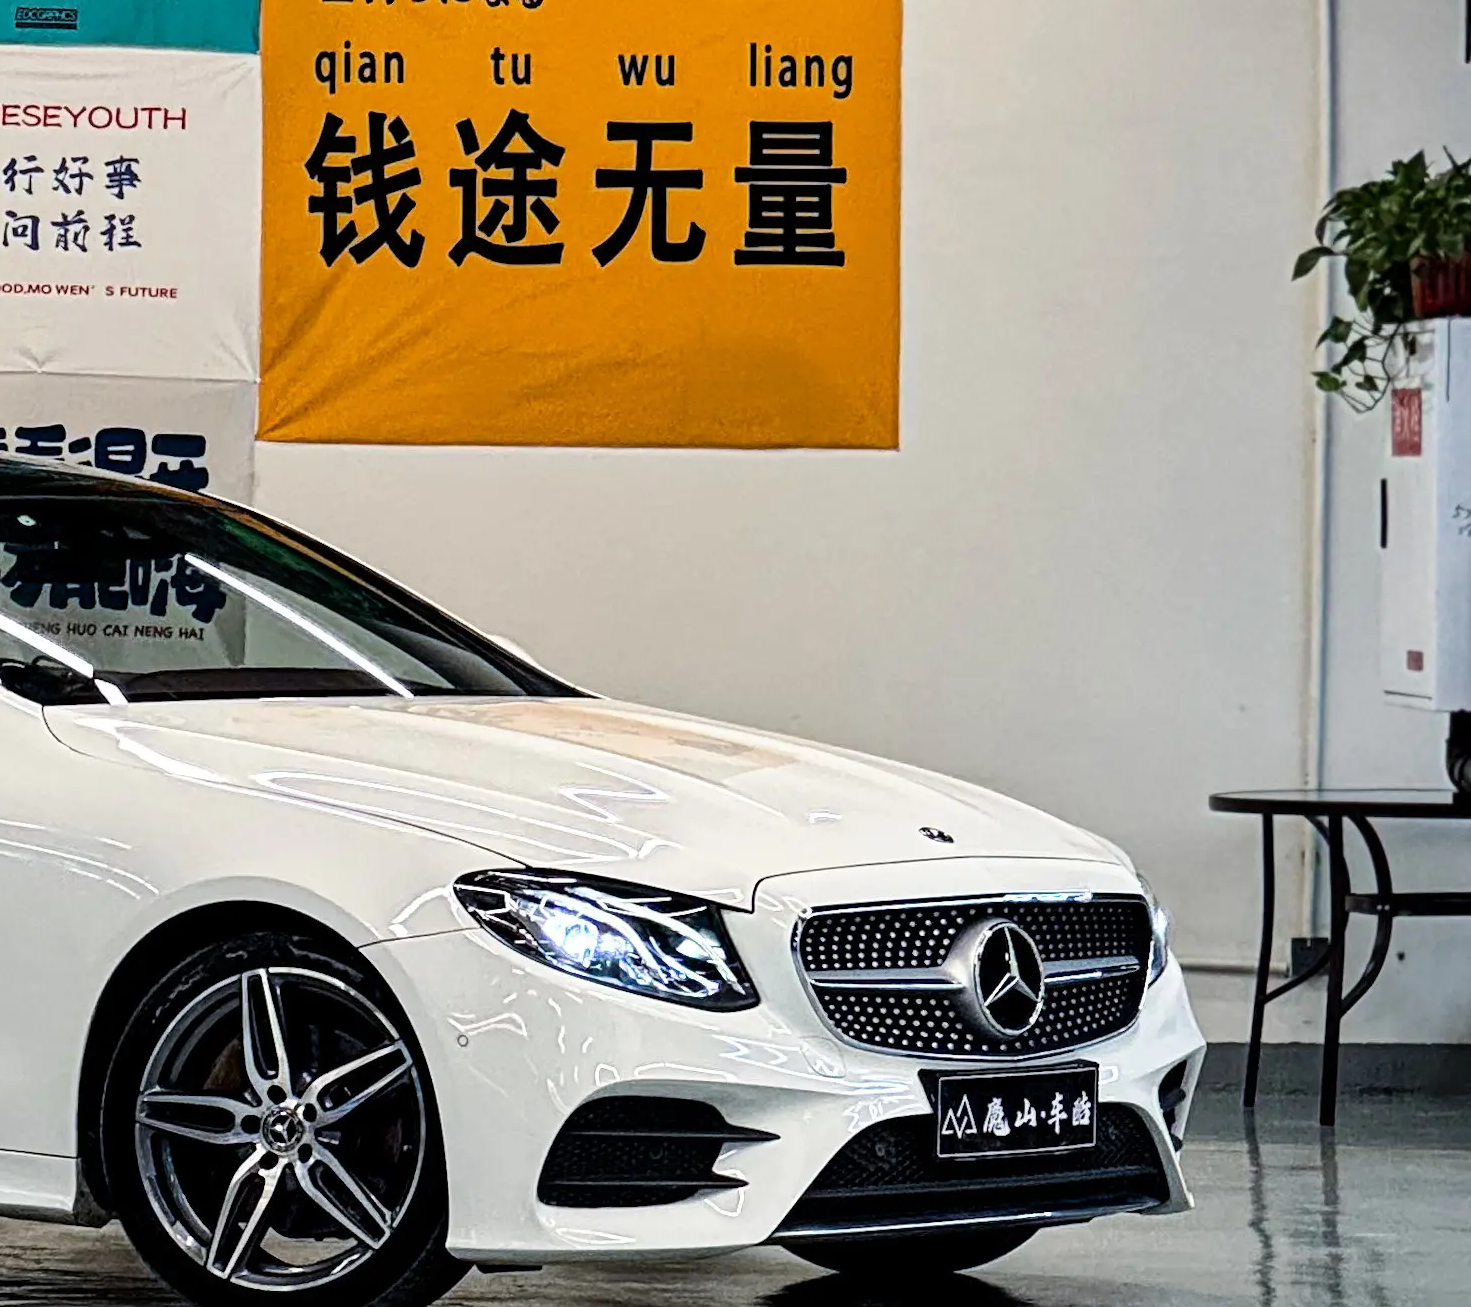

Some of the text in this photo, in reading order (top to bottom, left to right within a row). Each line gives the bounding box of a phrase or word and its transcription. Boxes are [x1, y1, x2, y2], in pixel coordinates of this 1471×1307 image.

[315, 41, 855, 99] qian tu wu liang
[305, 109, 848, 267] 钱途无量
[120, 287, 178, 299] FUTURE
[67, 622, 97, 636] HUO
[103, 624, 129, 637] CAI
[134, 625, 174, 638] NENG
[179, 628, 206, 641] HAI
